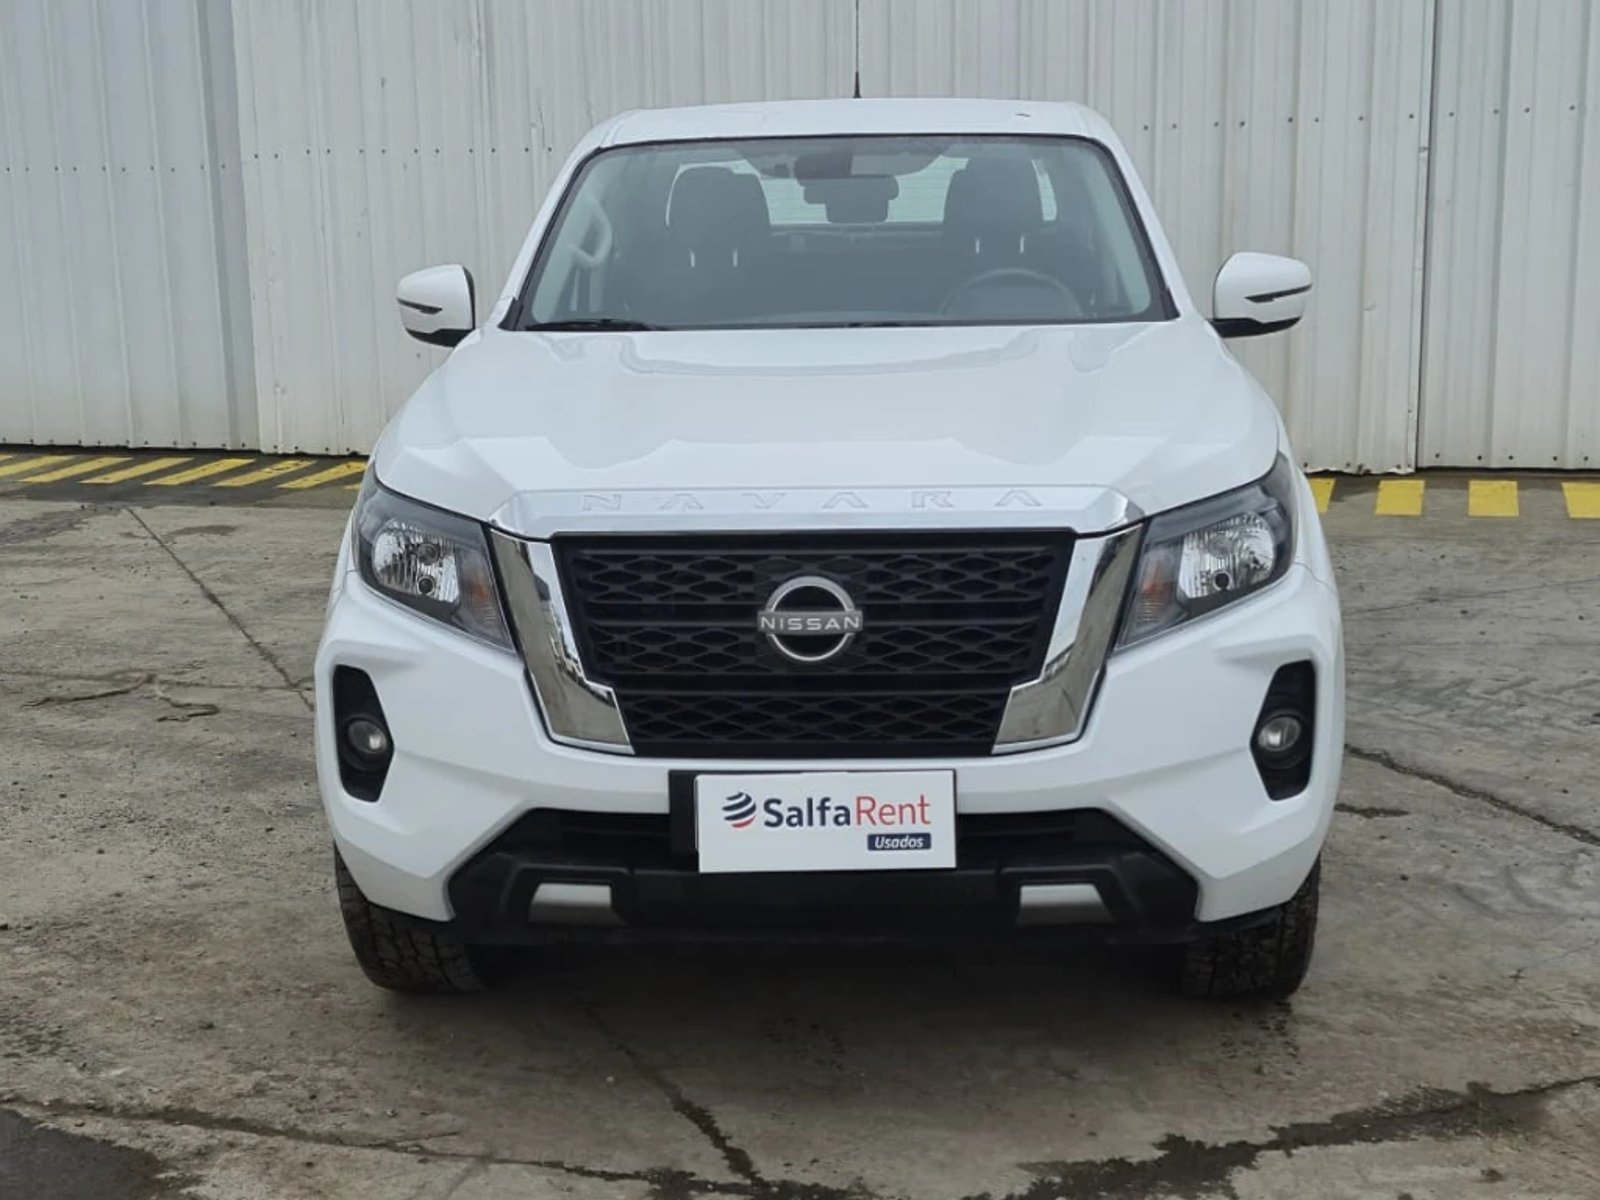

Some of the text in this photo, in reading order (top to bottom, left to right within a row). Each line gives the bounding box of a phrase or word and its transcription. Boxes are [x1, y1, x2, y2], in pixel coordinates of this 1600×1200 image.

[582, 489, 1042, 511] NAVARA
[761, 615, 861, 632] NISSAN
[874, 835, 924, 850] Usados
